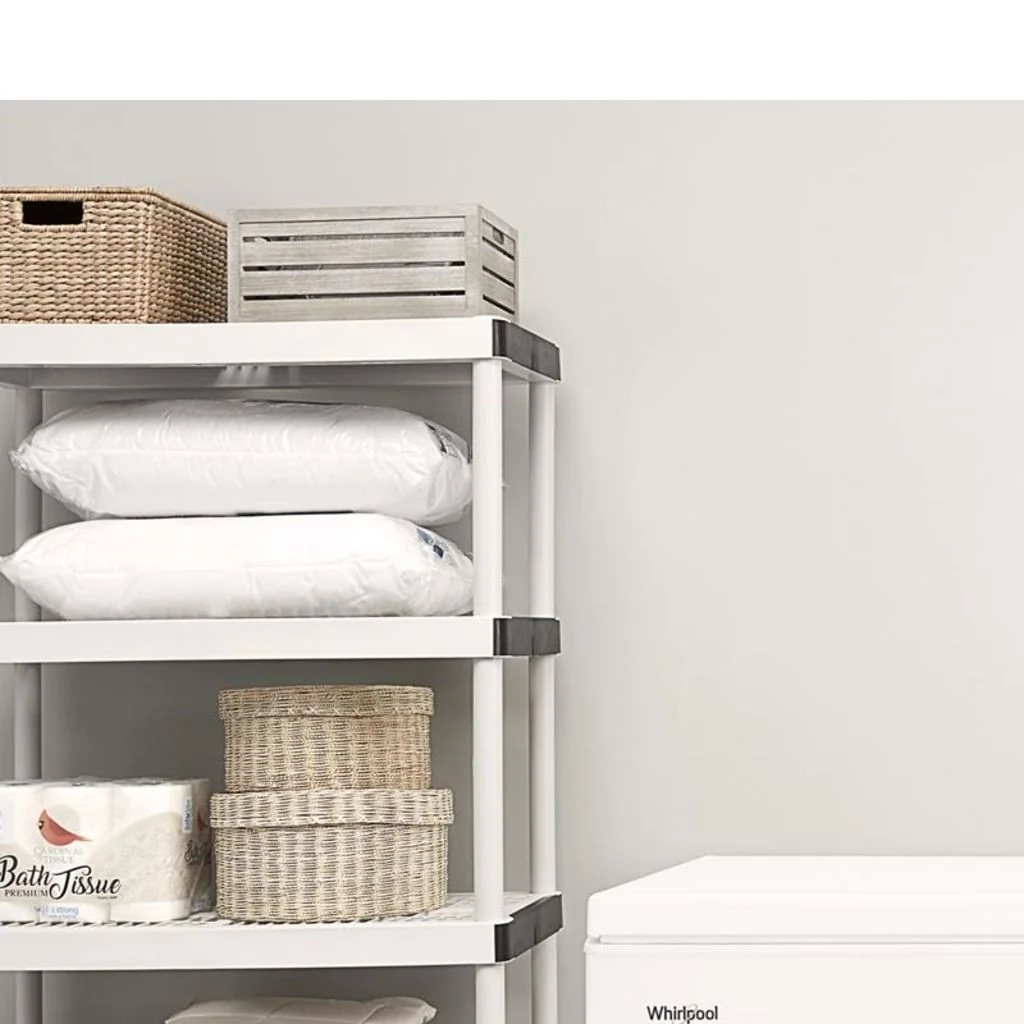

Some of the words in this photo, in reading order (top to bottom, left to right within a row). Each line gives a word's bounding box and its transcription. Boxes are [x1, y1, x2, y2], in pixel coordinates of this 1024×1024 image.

[0, 854, 51, 888] Bath
[50, 865, 122, 900] Tissue
[4, 889, 48, 897] PREMIUM
[646, 1005, 719, 1024] Whirlpool
